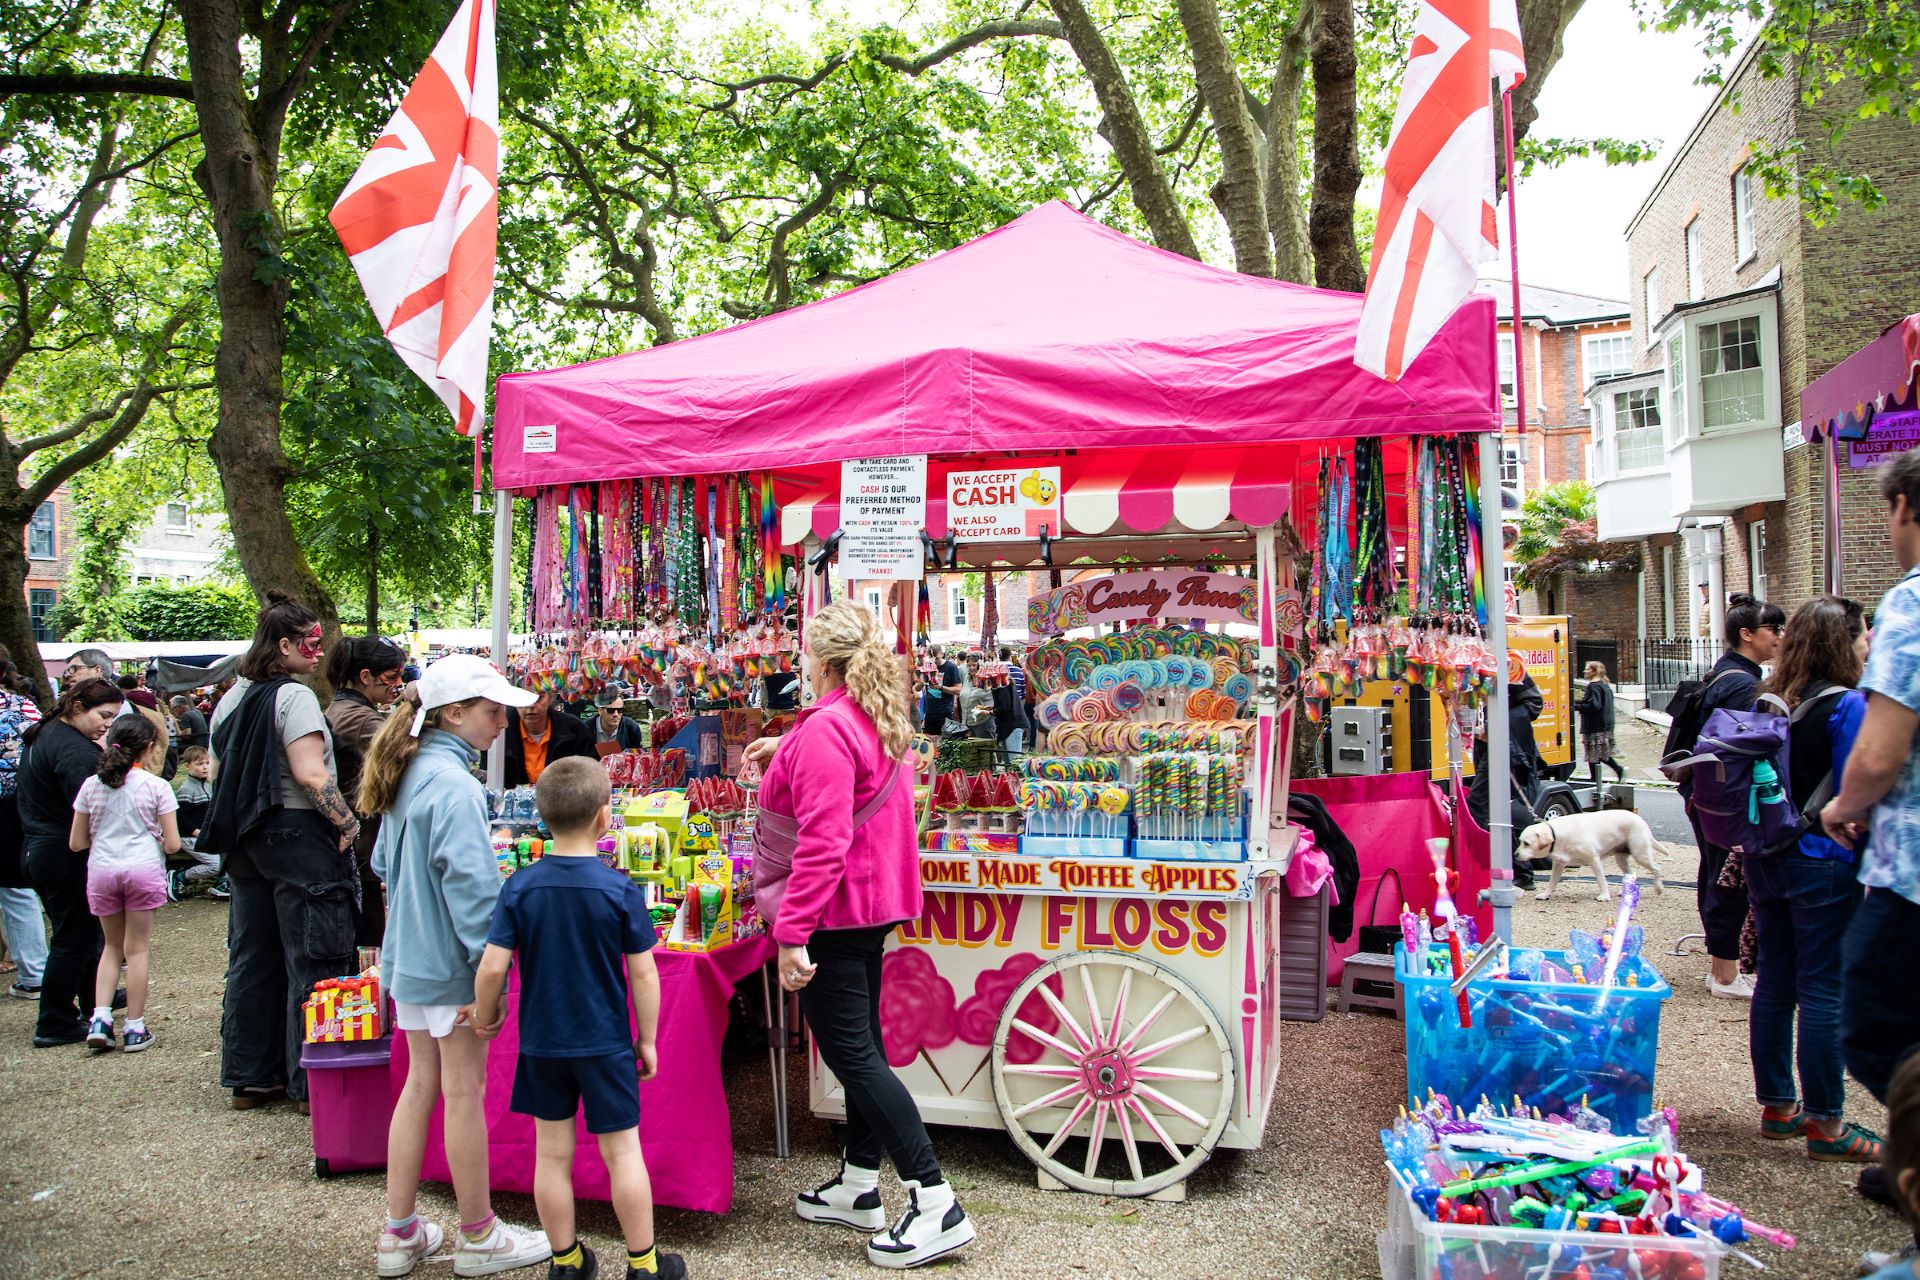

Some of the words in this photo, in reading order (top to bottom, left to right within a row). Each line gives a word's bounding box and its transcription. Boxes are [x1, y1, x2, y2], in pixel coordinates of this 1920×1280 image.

[1871, 419, 1887, 429] HE
[1889, 417, 1920, 427] STAF
[1868, 430, 1905, 440] ERATE
[1856, 442, 1888, 452] MUST
[1892, 441, 1916, 451] NOT
[1866, 455, 1880, 463] AT
[953, 476, 970, 485] WE
[973, 474, 1016, 484] ACCEPT
[882, 485, 889, 493] IS
[952, 486, 1015, 507] CASH
[954, 517, 968, 525] WE
[971, 516, 996, 525] ALSO
[954, 529, 990, 538] ACCEPT
[993, 527, 1020, 536] CARD
[1086, 578, 1171, 617] Candy
[1177, 576, 1245, 608] Time
[1528, 650, 1554, 664] iddall
[977, 859, 1042, 886] MADE
[1049, 861, 1135, 891] TOFFEE
[1141, 863, 1237, 893] APPLES
[894, 891, 1025, 947] NDY
[1041, 895, 1228, 957] FLOSS
